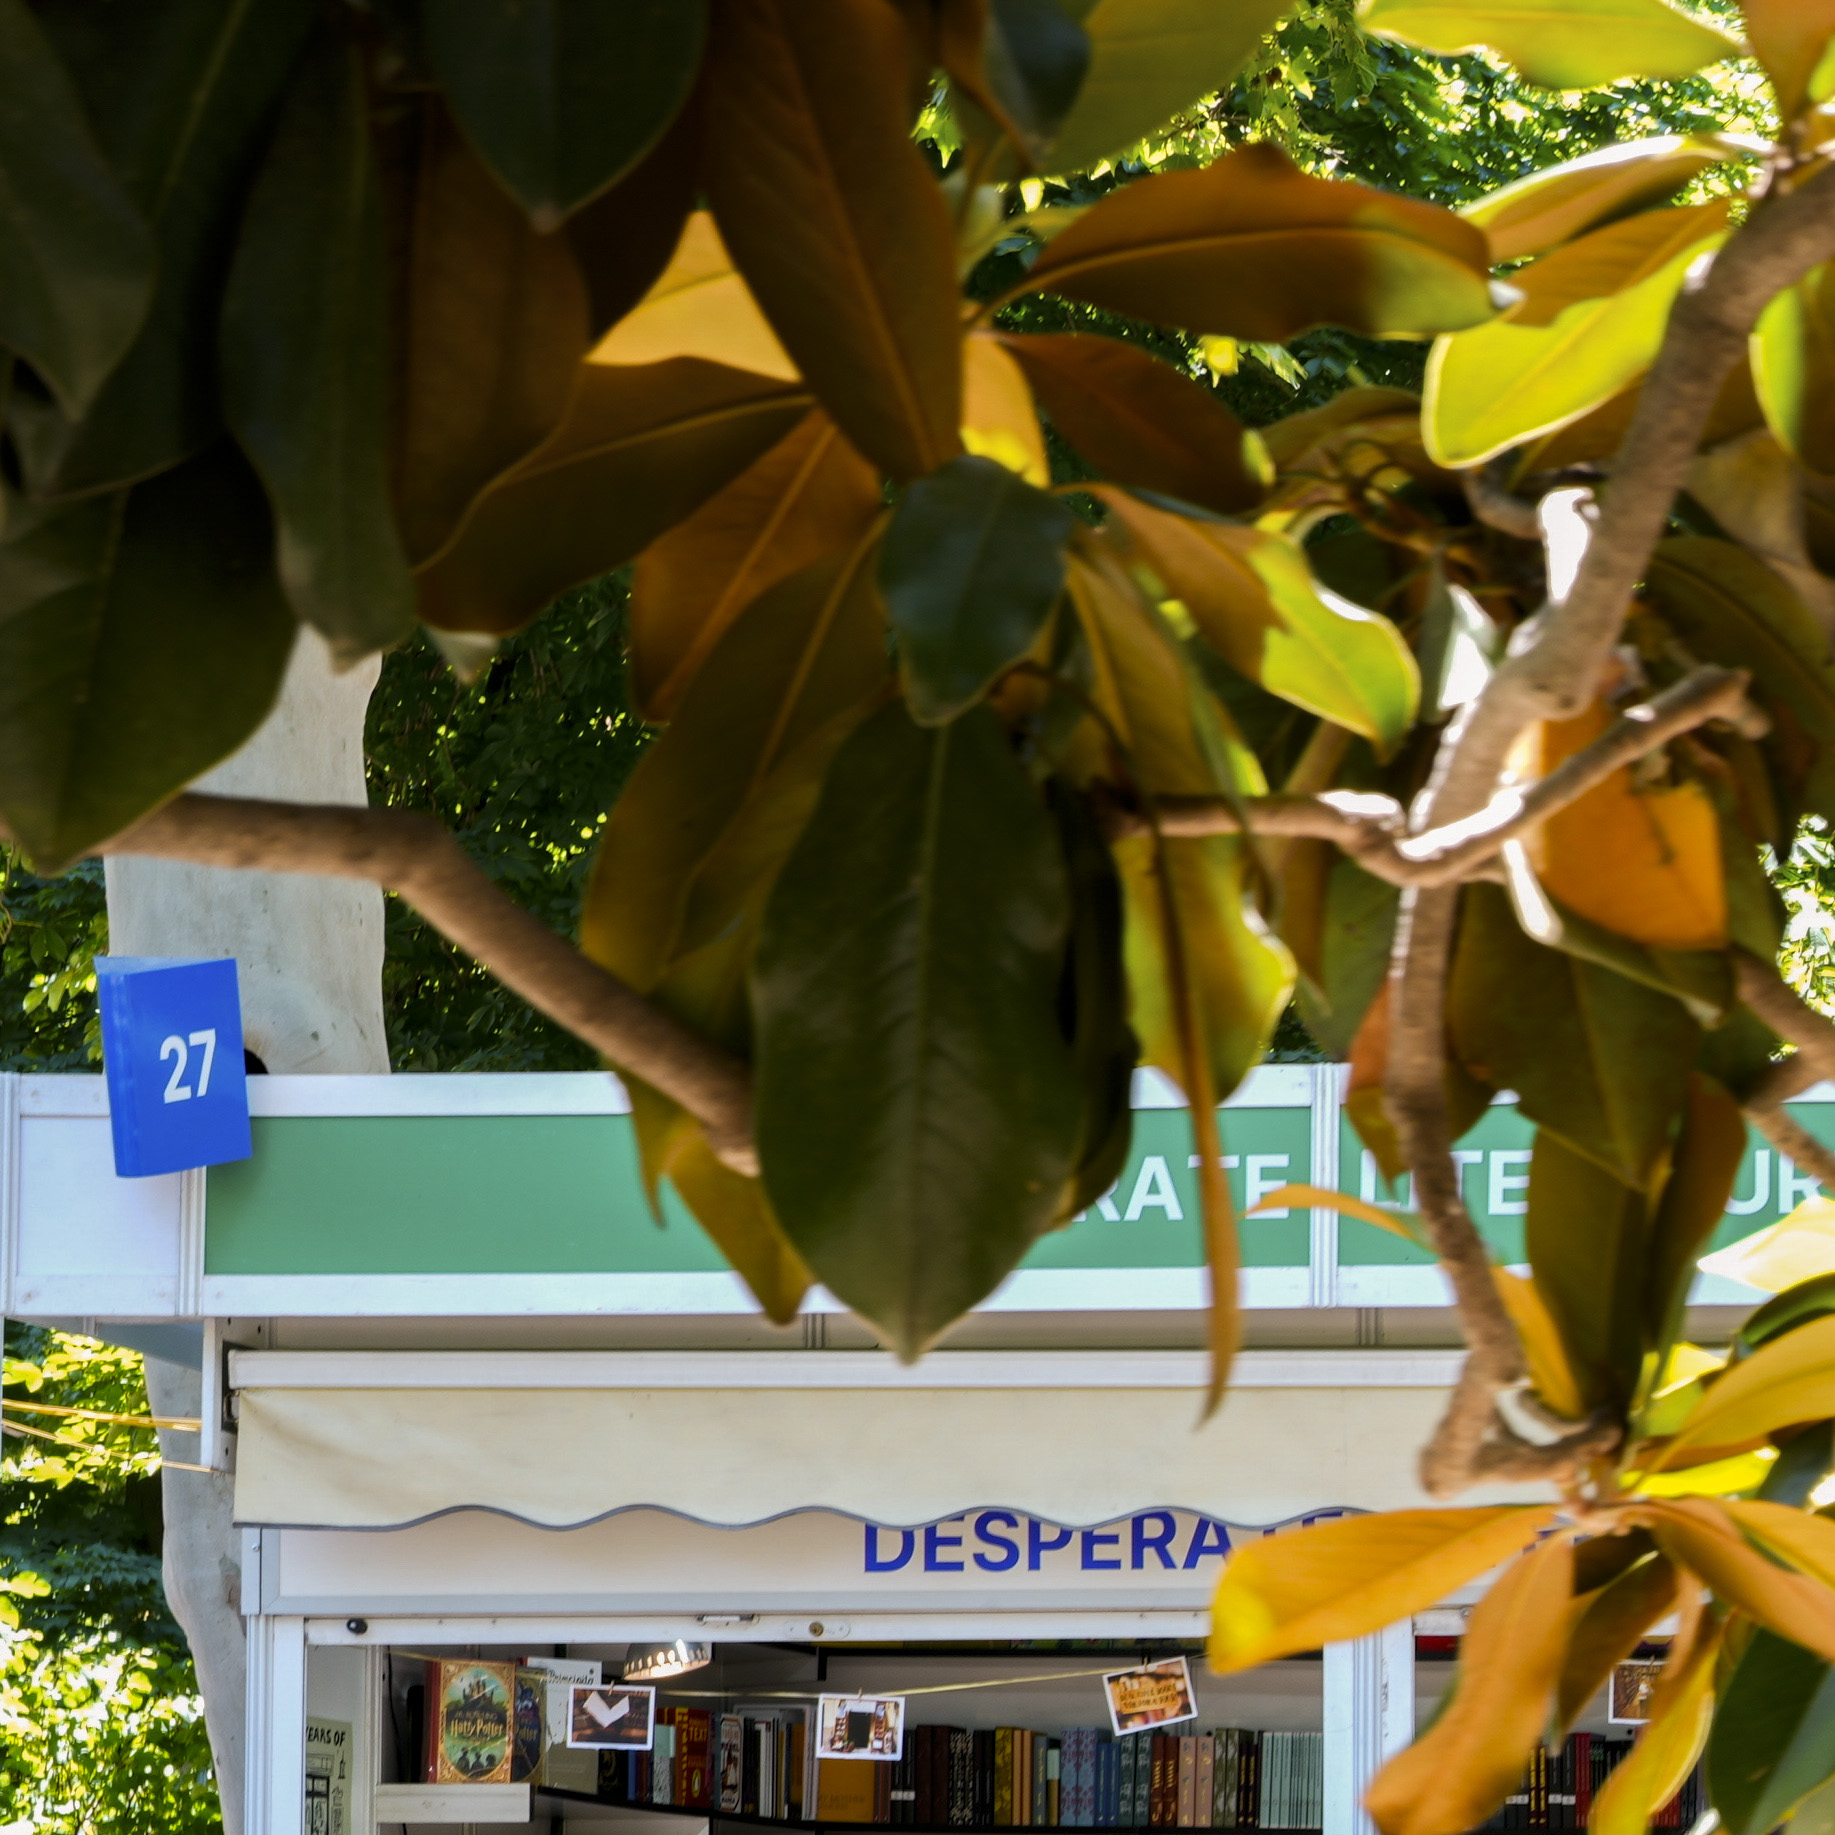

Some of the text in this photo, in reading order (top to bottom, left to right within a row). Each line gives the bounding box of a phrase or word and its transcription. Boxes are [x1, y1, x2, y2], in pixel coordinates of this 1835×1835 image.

[159, 1028, 216, 1104] 27
[333, 1730, 346, 1748] OF
[450, 1719, 504, 1739] Harry Potter
